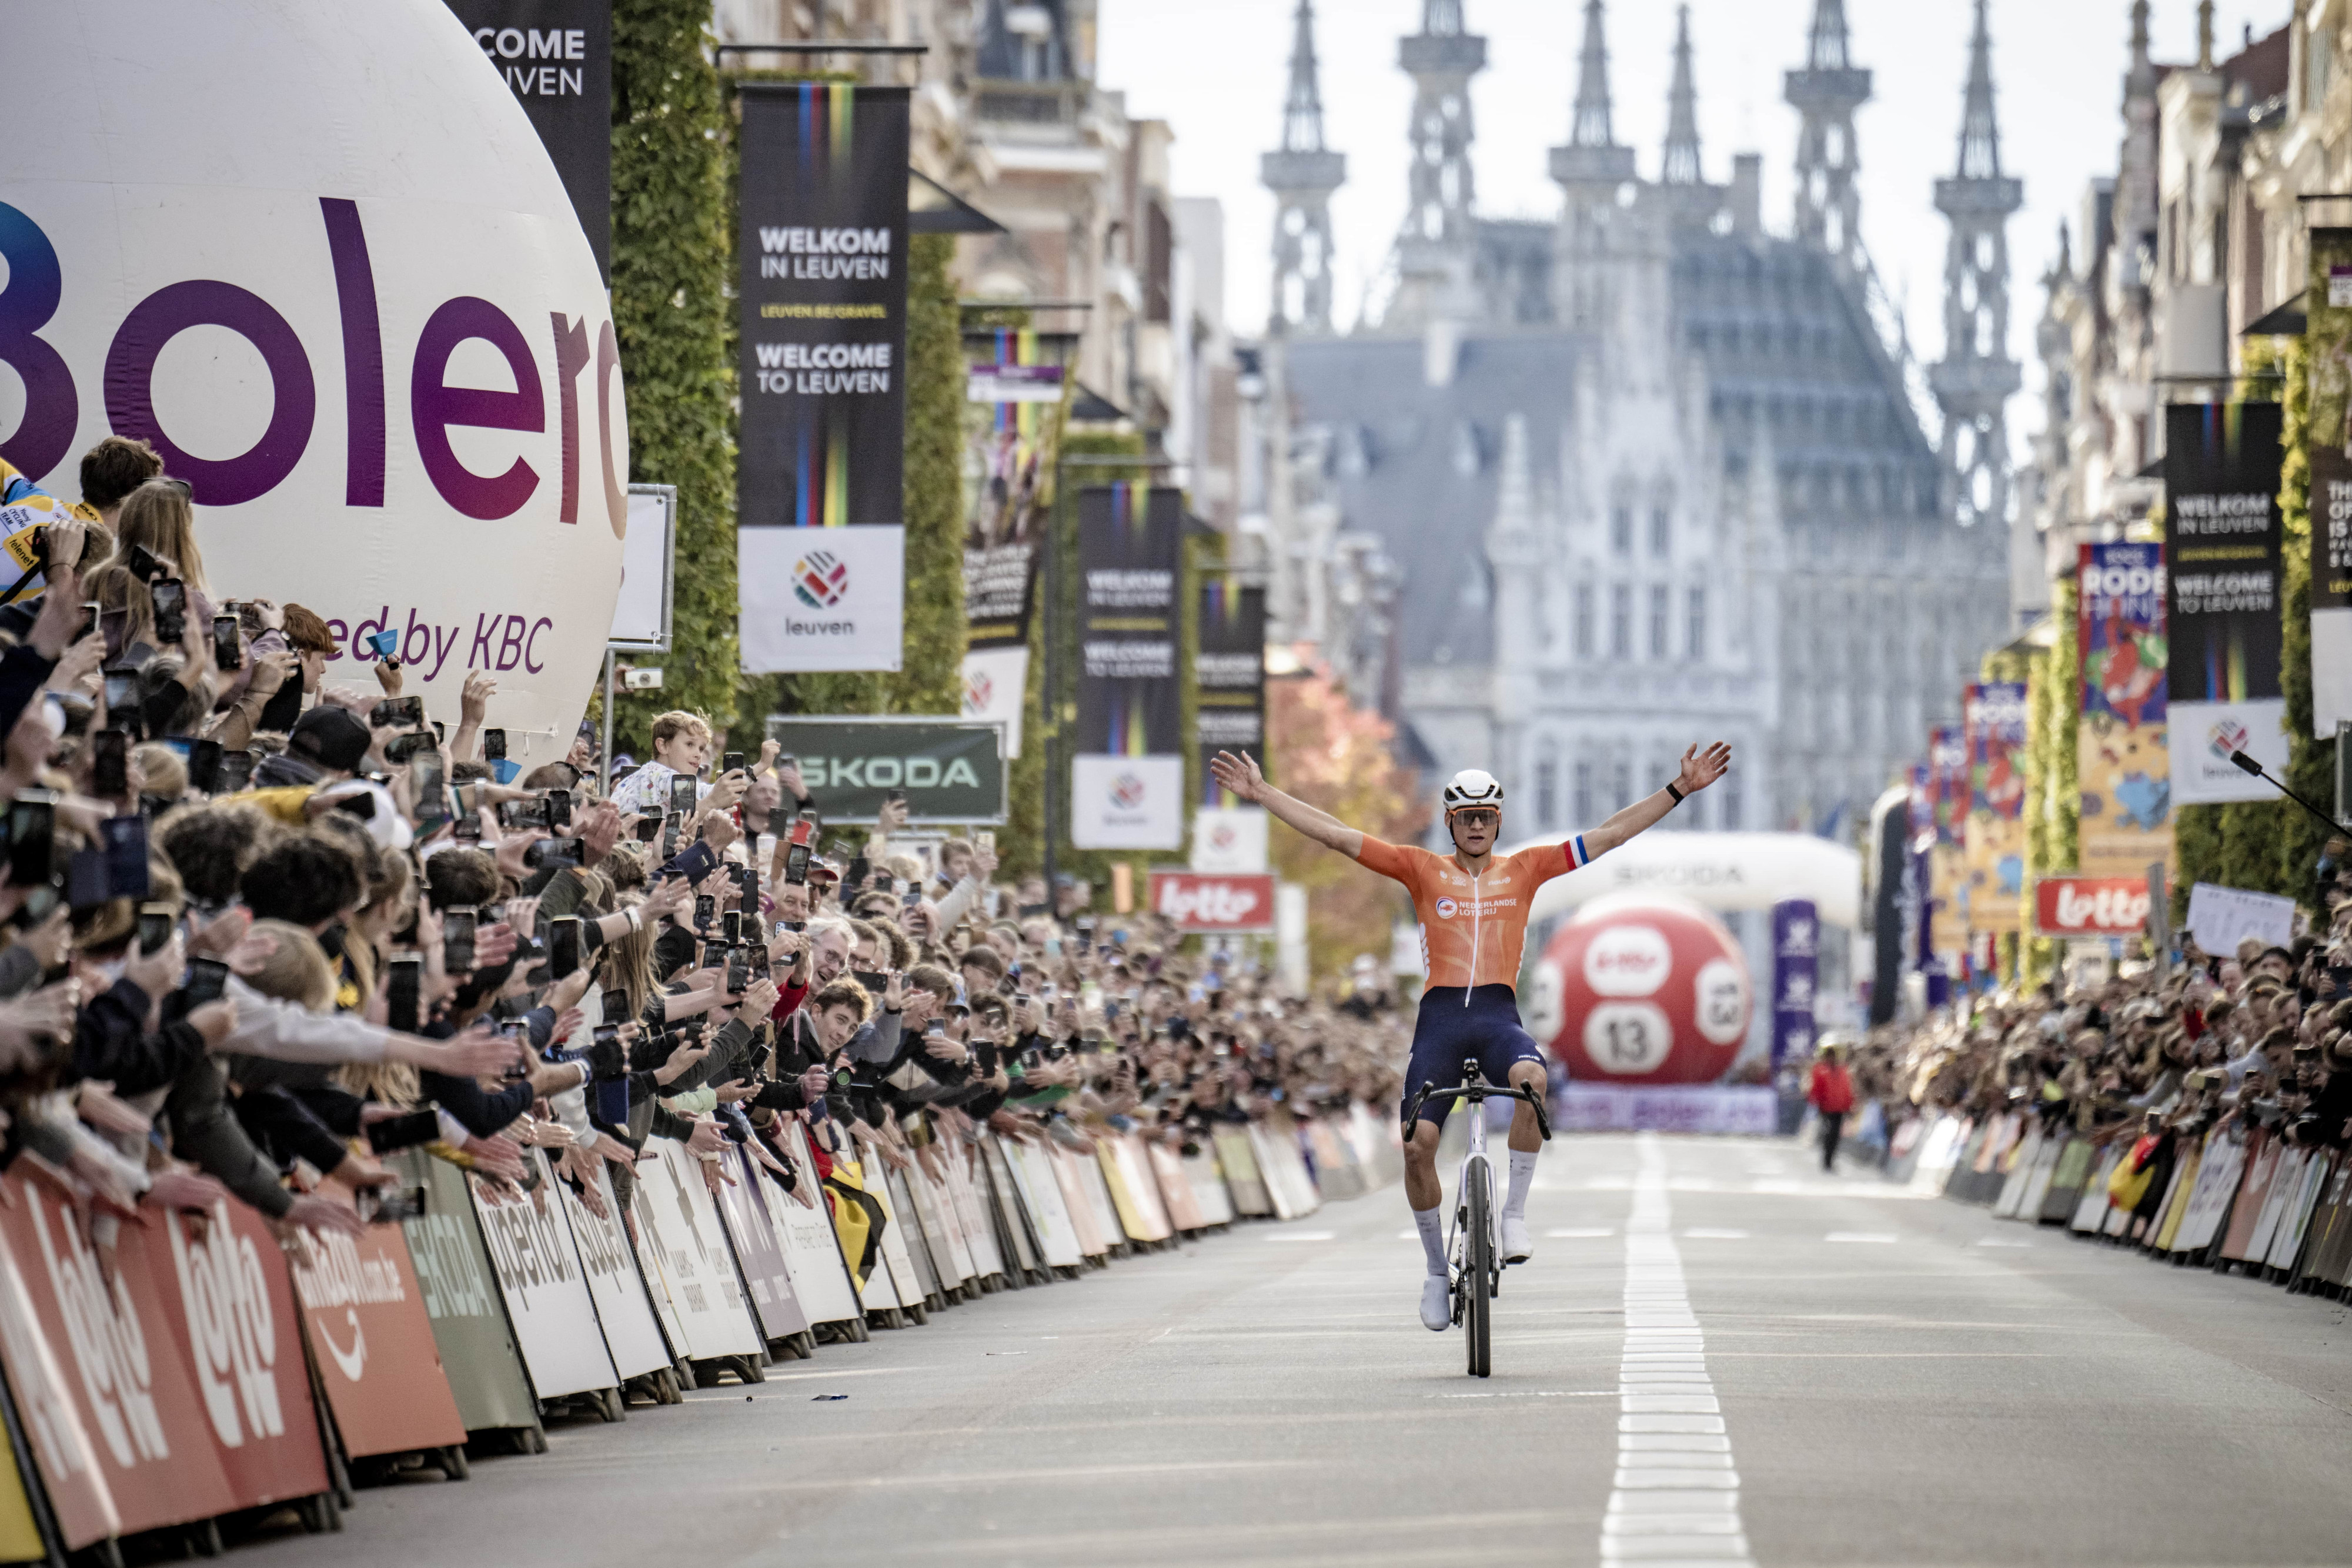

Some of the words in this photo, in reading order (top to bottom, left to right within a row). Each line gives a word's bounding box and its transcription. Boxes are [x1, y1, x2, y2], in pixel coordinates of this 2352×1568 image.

[473, 28, 584, 59] COME
[759, 228, 890, 254] WELKOM
[761, 257, 789, 279] IN
[794, 256, 888, 279] LEUVEN
[756, 343, 892, 367] WELCOME
[757, 370, 790, 393] TO
[797, 370, 889, 394] LEUVEN
[2177, 494, 2270, 517] WELKOM
[1, 511, 14, 525] TEAM
[9, 508, 26, 528] CYCLING
[2200, 516, 2269, 534] LEUVEN
[9, 539, 35, 567] telenet
[2176, 571, 2273, 596] WELCOME
[2177, 597, 2200, 613] TO
[2204, 594, 2273, 612] LEUVEN
[785, 617, 854, 636] leuven
[401, 609, 459, 682] by
[467, 613, 552, 674] KBC
[1459, 898, 1517, 910] NEDERLANDSE
[1459, 907, 1496, 917] LOTERIJ
[1606, 1018, 1648, 1062] 13
